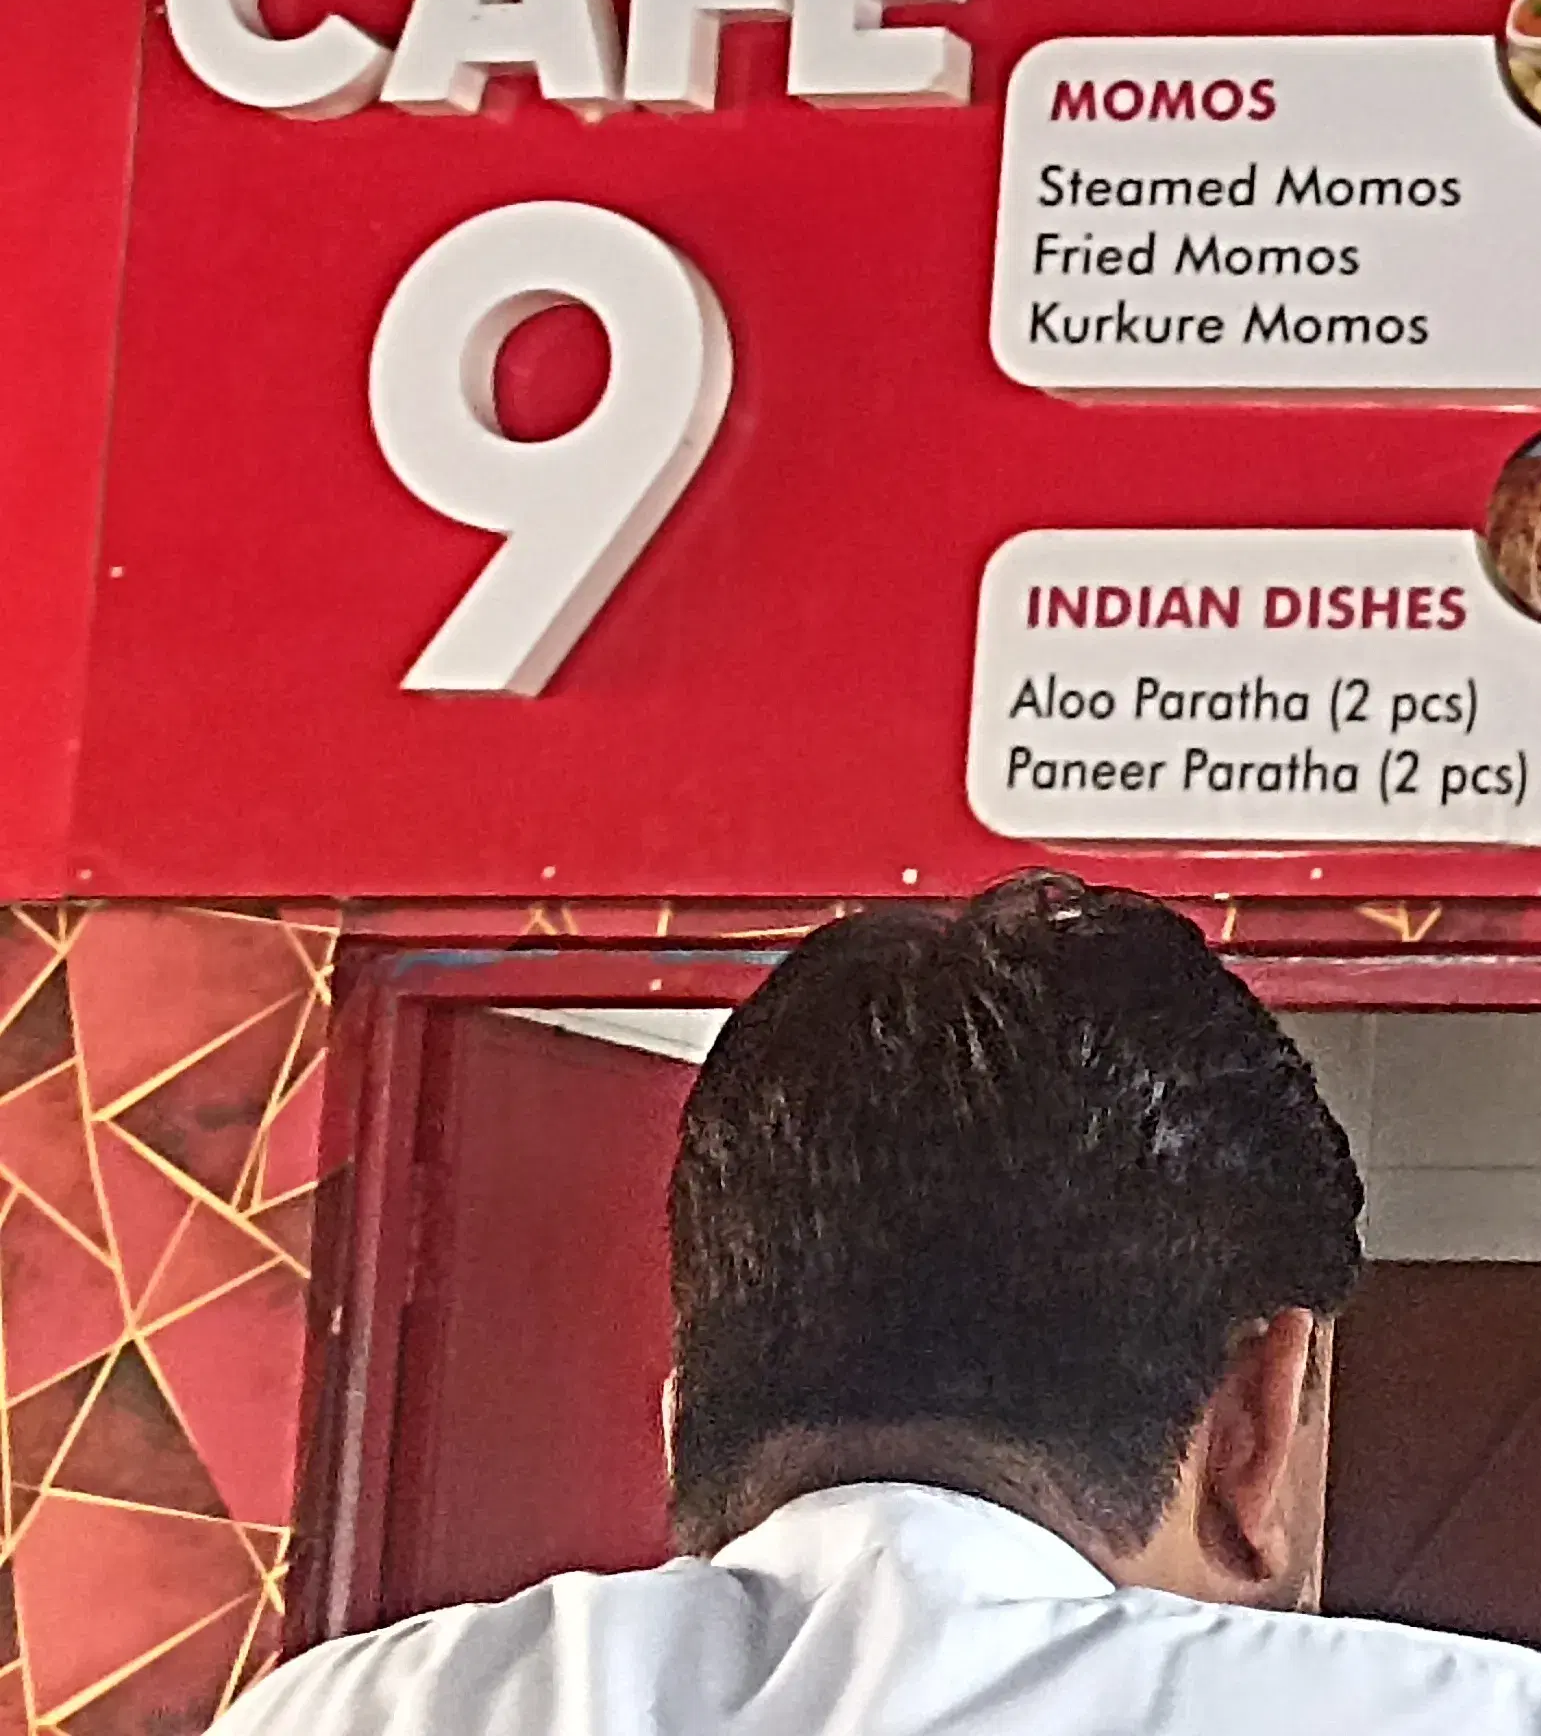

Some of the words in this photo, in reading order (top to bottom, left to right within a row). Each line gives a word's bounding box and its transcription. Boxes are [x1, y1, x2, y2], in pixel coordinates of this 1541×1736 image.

[1050, 78, 1276, 122] MOMOS
[1039, 162, 1257, 207] Steamed
[1275, 166, 1461, 207] Momos
[1034, 231, 1156, 276] Fried
[1174, 235, 1360, 276] Momos
[1030, 299, 1225, 345] Kurkure
[1243, 304, 1429, 345] Momos
[367, 199, 735, 700] 9
[1027, 585, 1240, 629] INDIAN
[1263, 585, 1467, 631] DISHES
[1009, 673, 1116, 720] Aloo
[1135, 675, 1309, 722] Paratha
[1330, 678, 1370, 733] (2
[1390, 678, 1477, 735] pcs)
[1006, 745, 1166, 791] Paneer
[1183, 747, 1359, 794] Paratha
[1379, 748, 1419, 805] (2
[1440, 750, 1527, 807] pcs)
